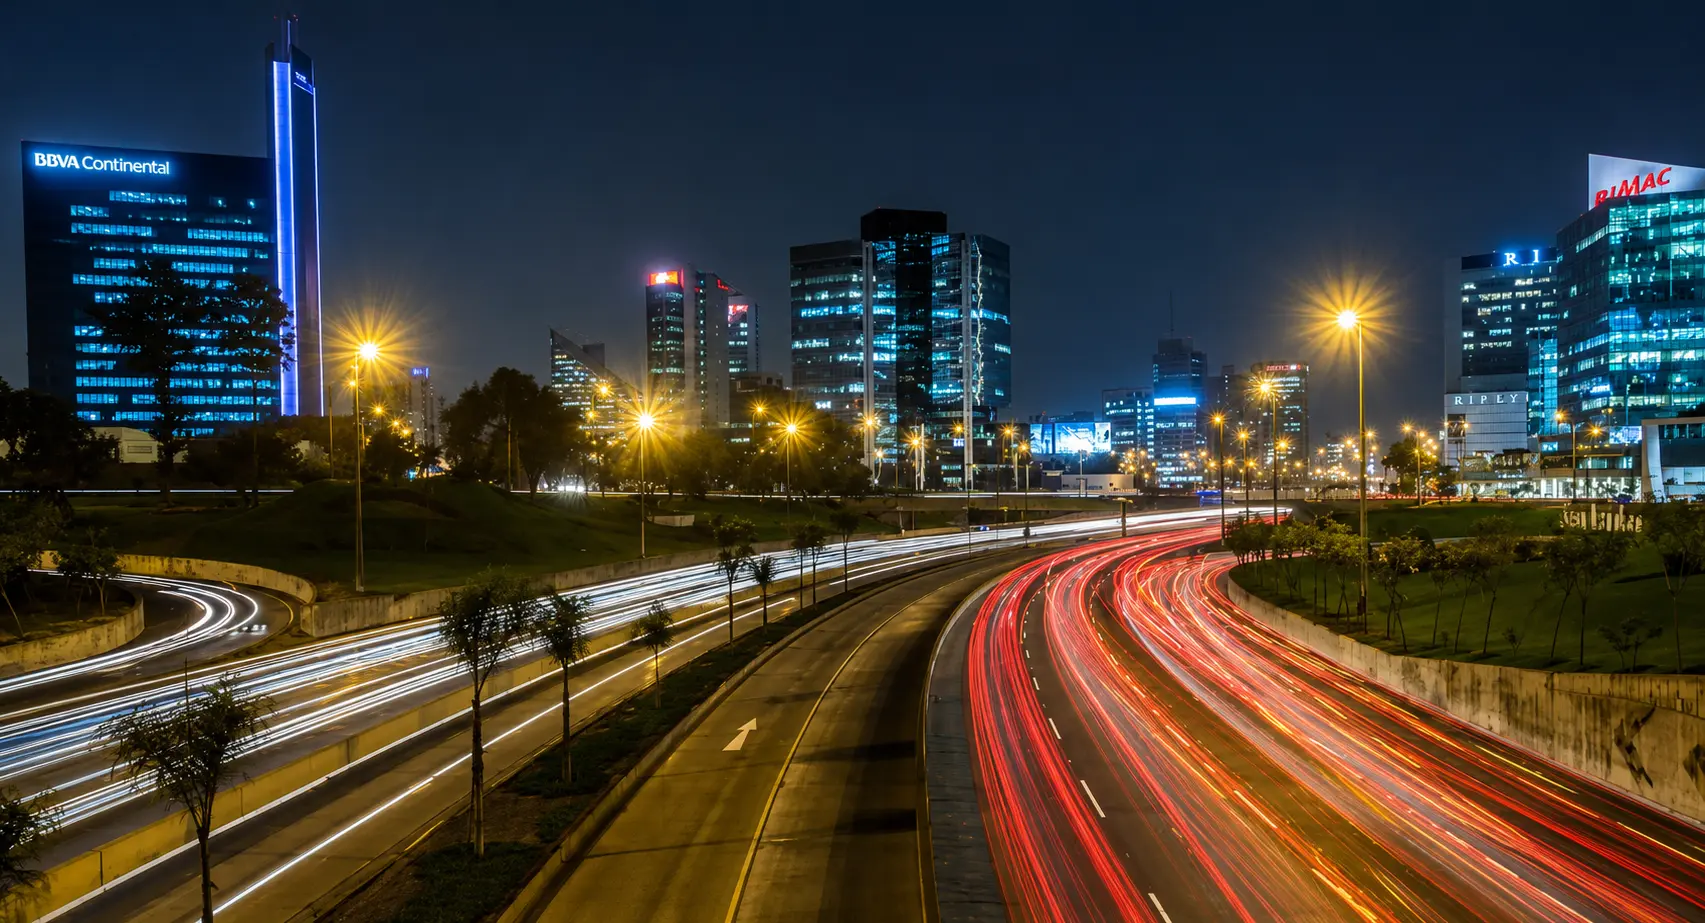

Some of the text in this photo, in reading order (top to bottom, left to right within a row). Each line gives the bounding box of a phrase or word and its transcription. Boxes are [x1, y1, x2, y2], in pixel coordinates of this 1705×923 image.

[34, 152, 170, 175] BBVA Continental
[1594, 167, 1672, 208] RIMAC
